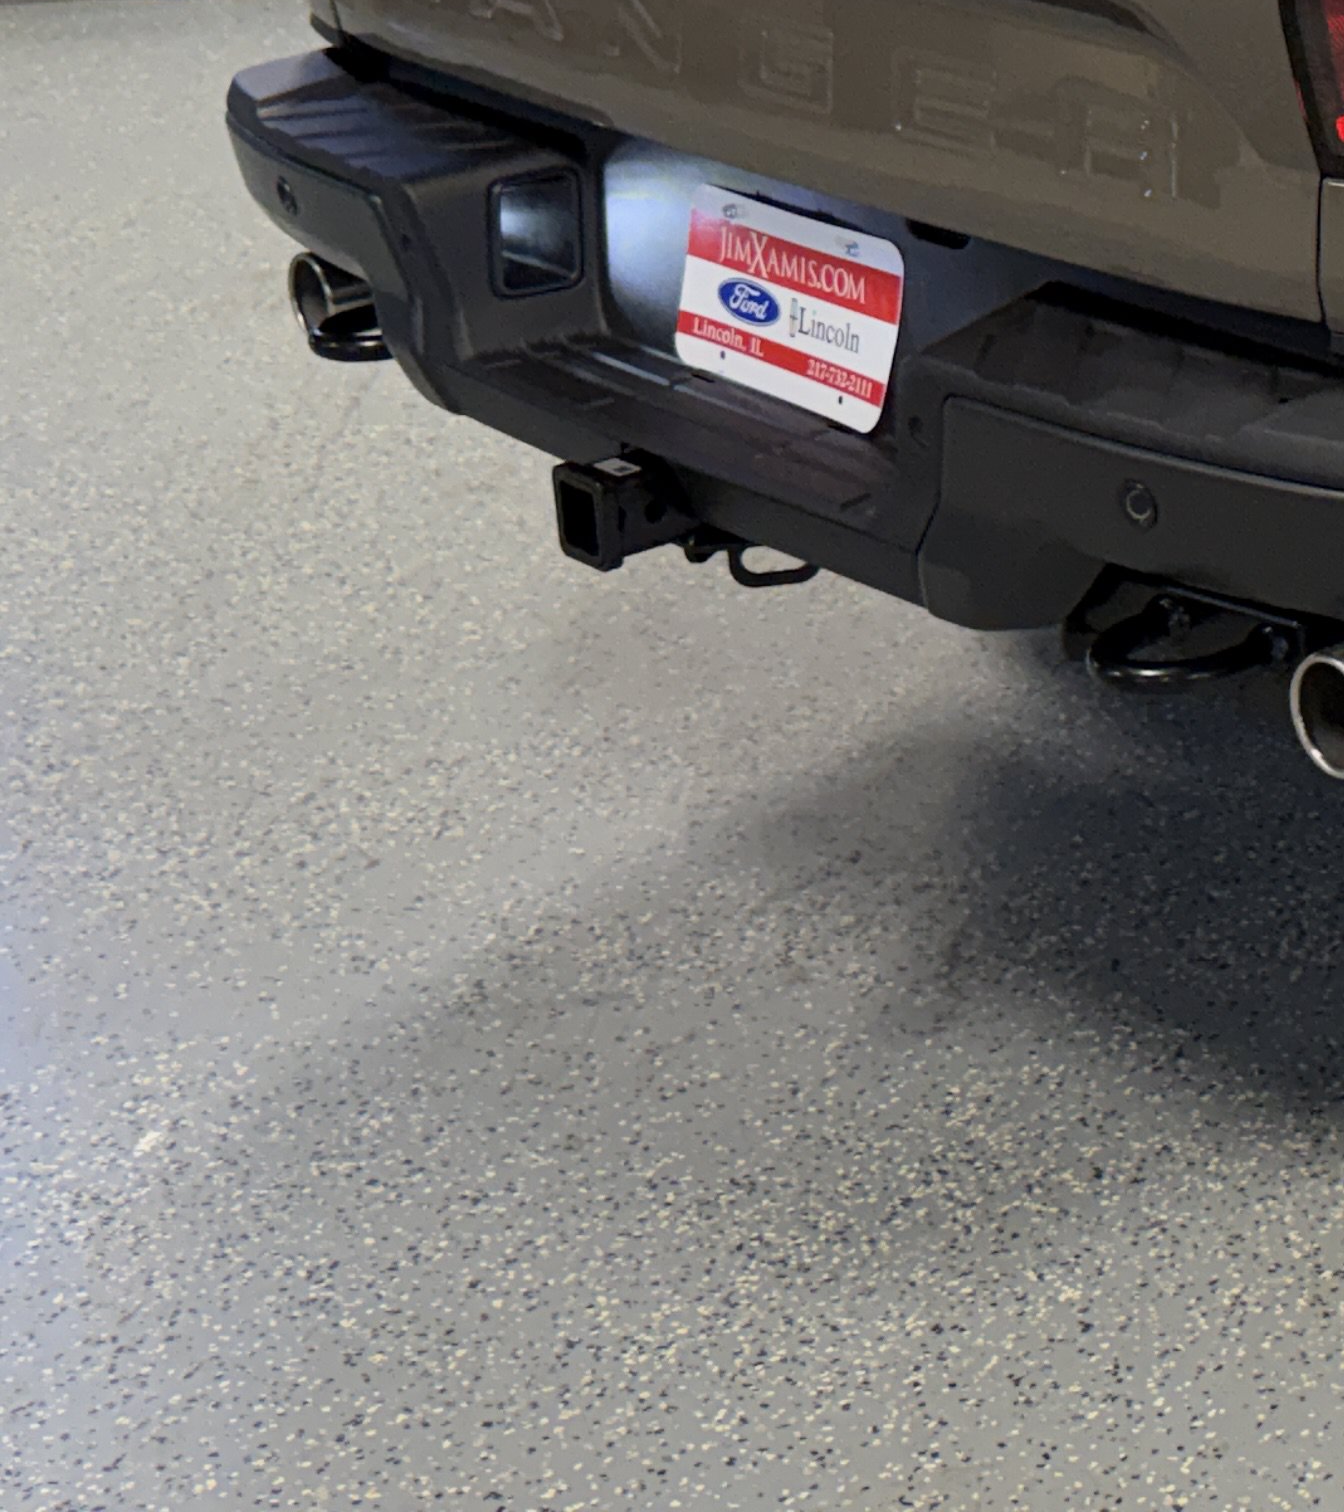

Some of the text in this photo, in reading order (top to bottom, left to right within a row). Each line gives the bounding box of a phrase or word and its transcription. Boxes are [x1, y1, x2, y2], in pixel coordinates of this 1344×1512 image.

[729, 283, 769, 321] Ford
[750, 336, 764, 357] IL
[798, 306, 860, 354] Lincoln
